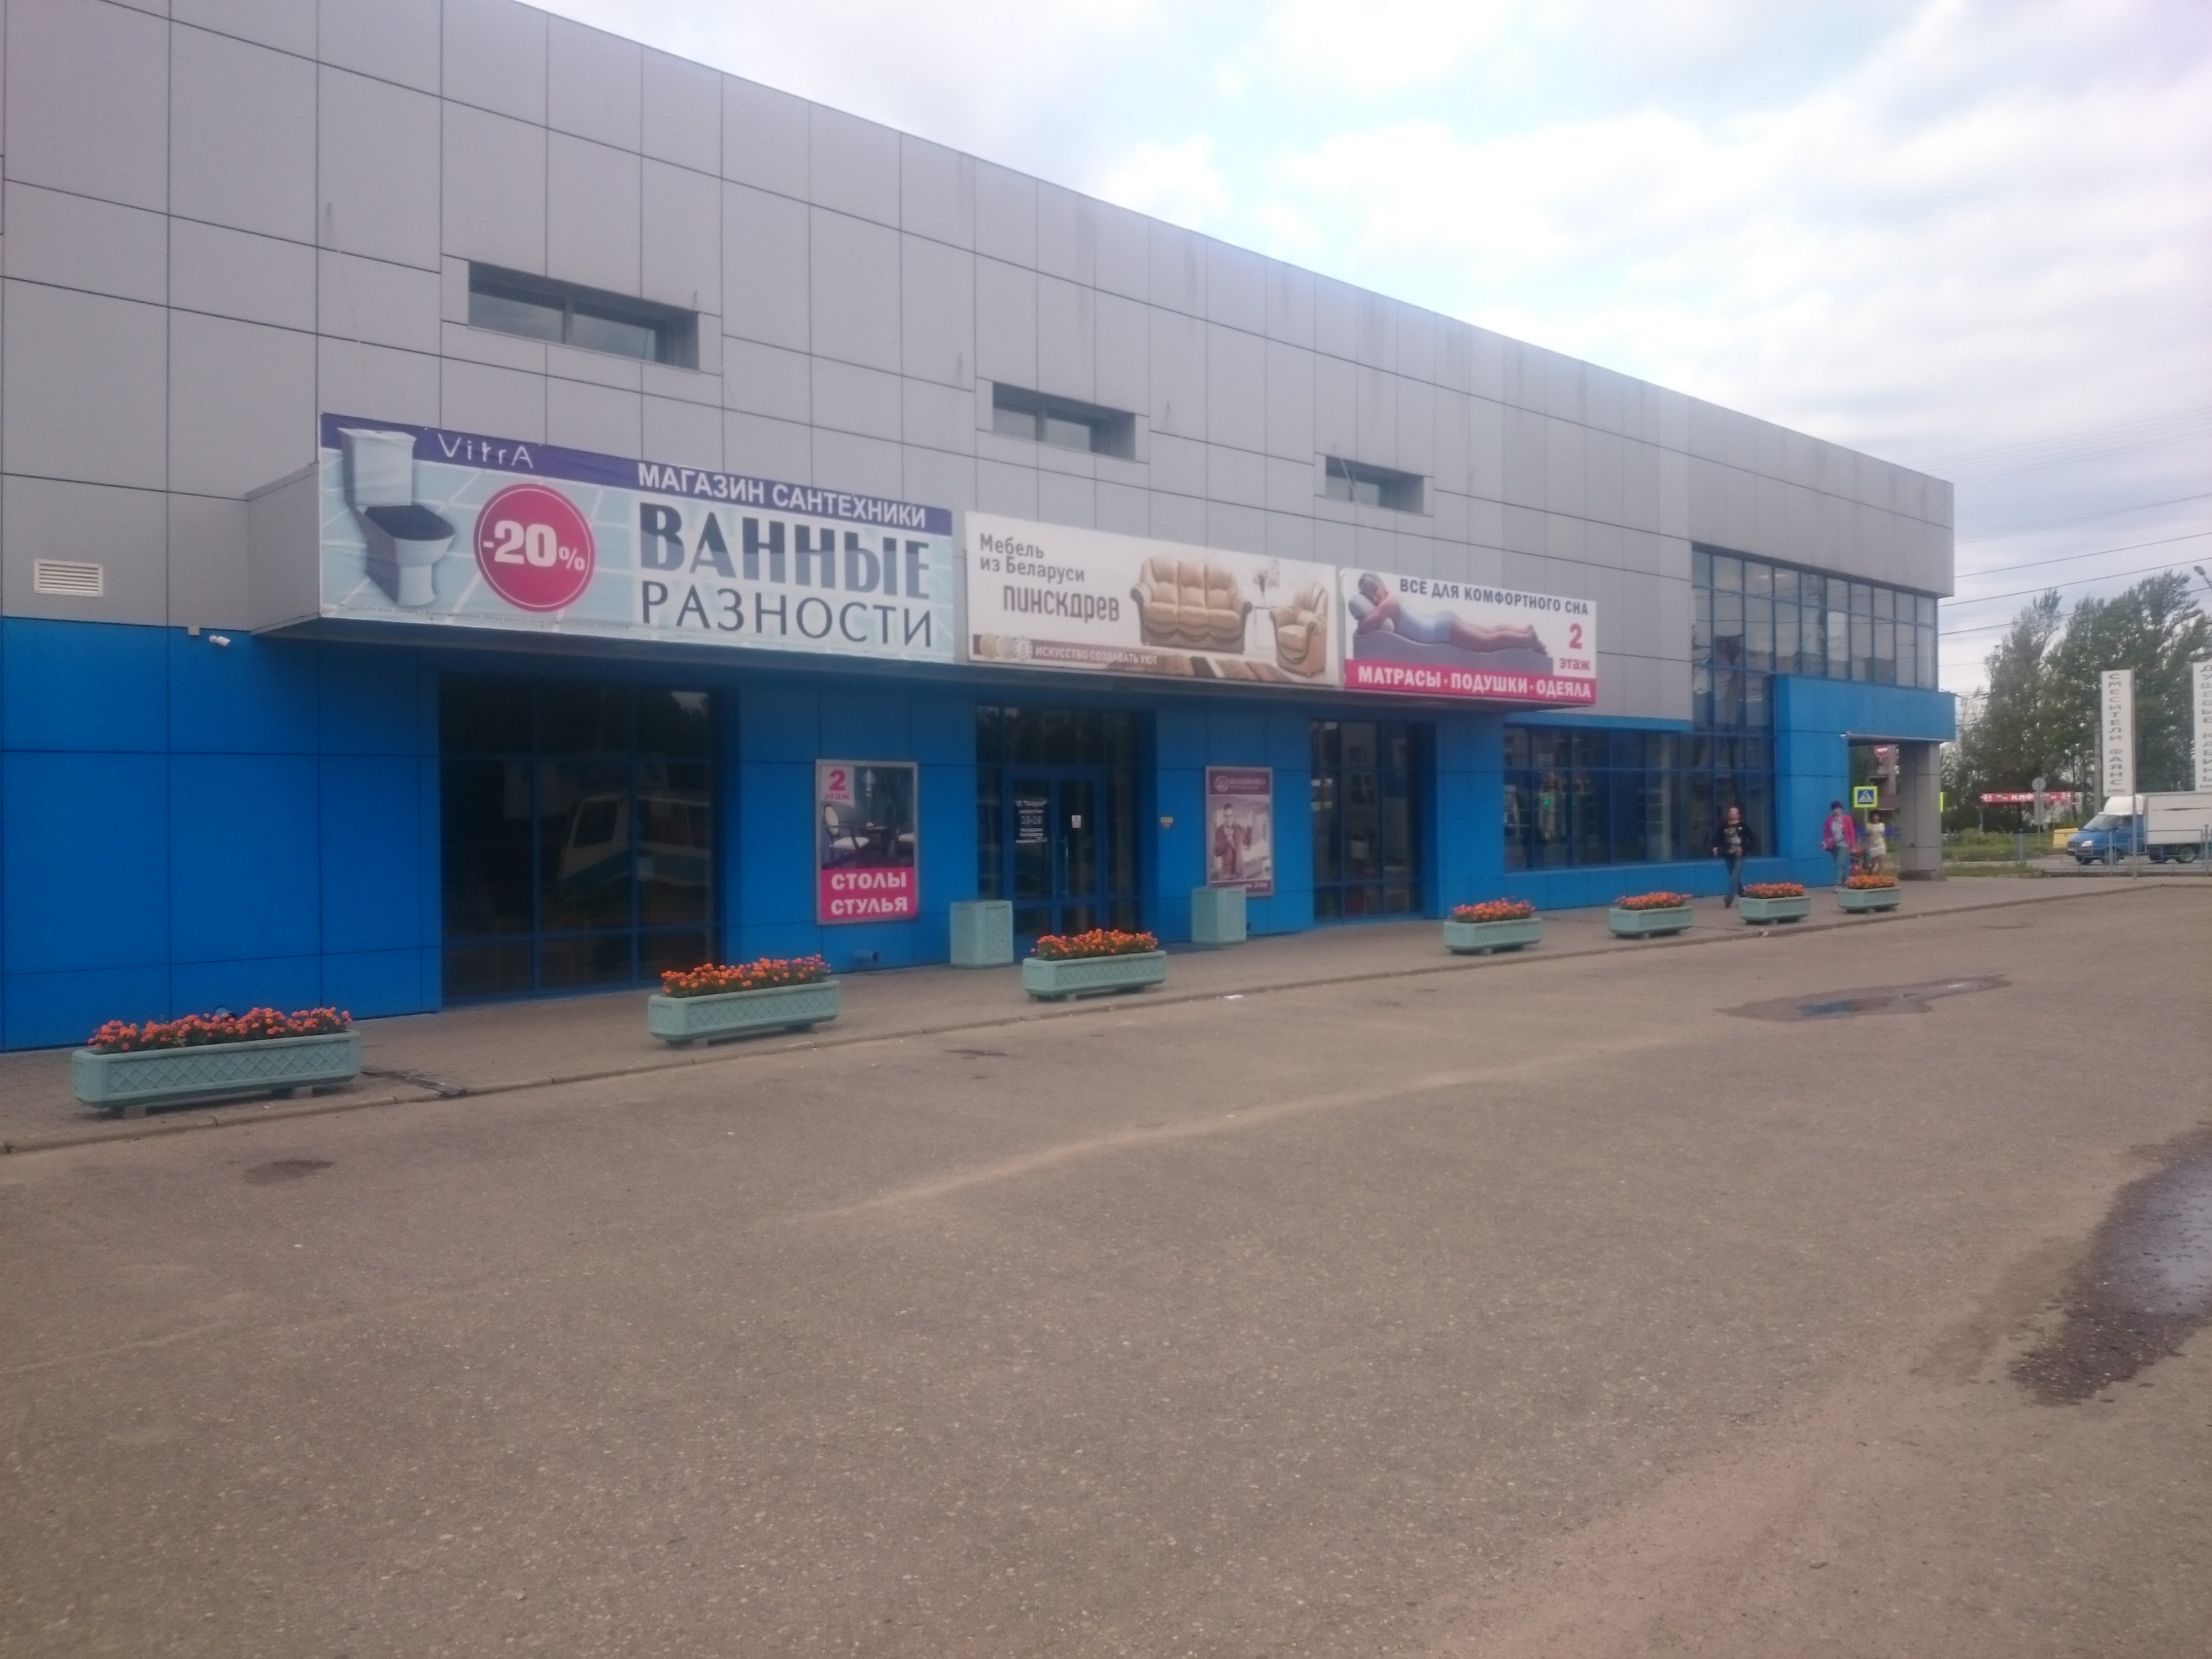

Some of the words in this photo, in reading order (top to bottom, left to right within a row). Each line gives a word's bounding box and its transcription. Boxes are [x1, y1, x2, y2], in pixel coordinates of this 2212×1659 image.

[438, 434, 533, 468] VitrA
[638, 463, 764, 505] МАГАЗИН
[772, 483, 926, 529] САНТЕХНИКИ
[640, 502, 929, 600] ВАННЫЕ
[980, 533, 1044, 558] Мебель
[980, 556, 1000, 572] из
[1006, 556, 1084, 583] Беларуси
[1431, 583, 1459, 599] ДЛЯ
[1465, 588, 1560, 611] КОМФОРТНОГО
[1565, 599, 1589, 615] СНА
[642, 581, 931, 648] РАЗНОСТИ
[1569, 623, 1582, 649] 2
[1036, 647, 1086, 659] ИСКУССТВО
[1090, 651, 1138, 663] СОЗДАВАТЬ
[1140, 655, 1157, 665] УЮТ
[1559, 657, 1591, 671] этаж
[1358, 665, 1441, 687] МАТРАСЫ
[1451, 672, 1528, 694] ПОДУШКИ
[1536, 680, 1591, 698] ОДЕЯЛА
[2108, 673, 2122, 741] СМЕСИТЕЛИ
[829, 770, 846, 791] 2
[832, 872, 906, 889] СТОЛЫ
[832, 897, 907, 915] СТУЛЬЯ
